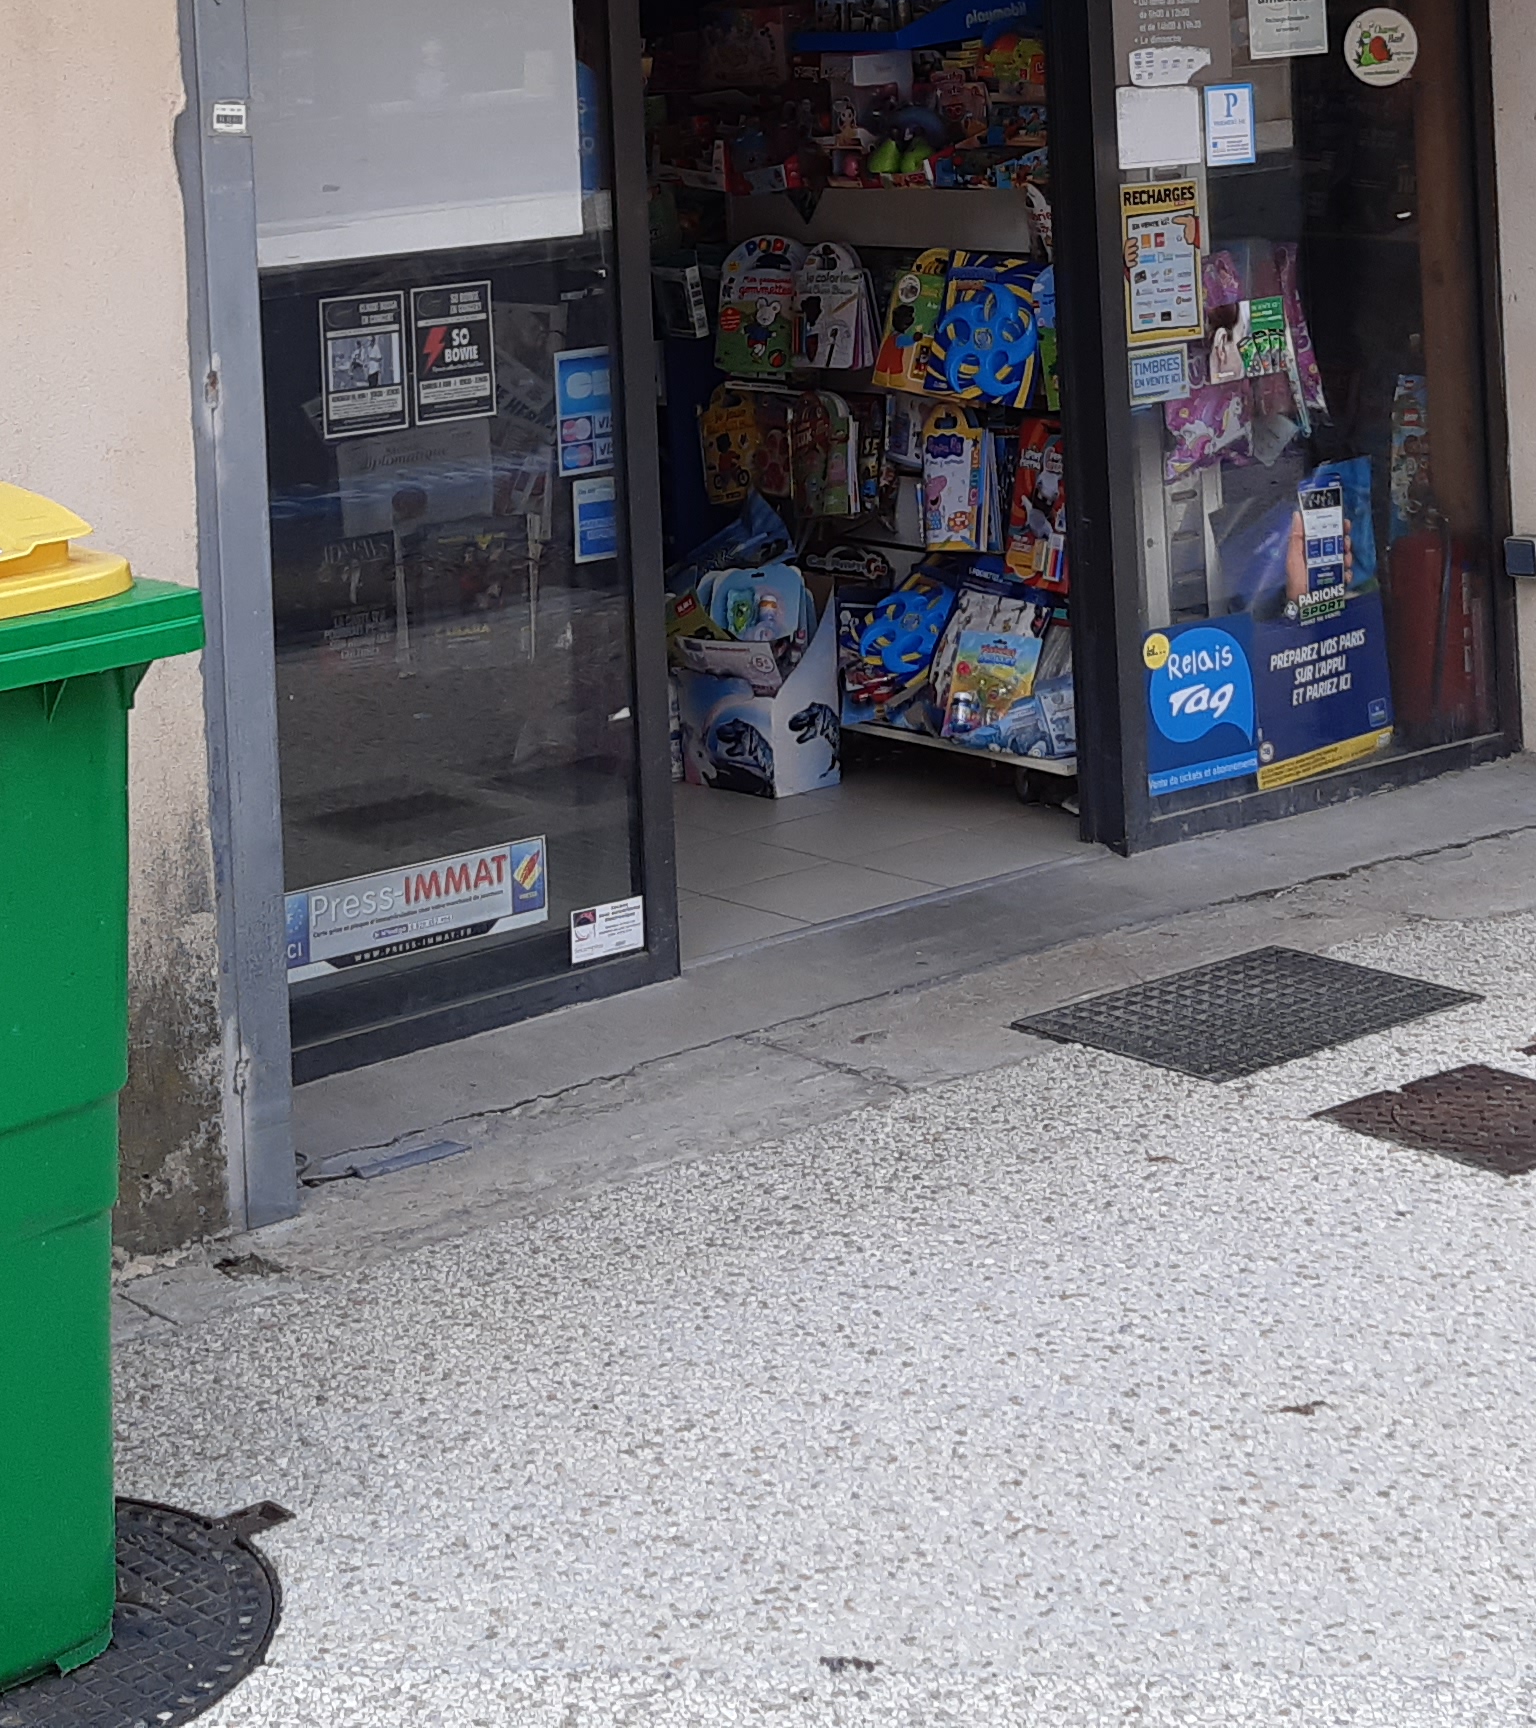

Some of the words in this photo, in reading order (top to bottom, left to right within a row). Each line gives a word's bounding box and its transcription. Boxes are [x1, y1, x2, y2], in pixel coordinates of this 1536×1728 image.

[965, 1, 1027, 28] playmobil
[1123, 185, 1195, 207] RECHARGES
[451, 328, 470, 347] SO
[444, 345, 479, 363] BOWIE
[1133, 357, 1180, 376] TIMBRES
[1135, 378, 1146, 388] EN
[1147, 376, 1170, 386] VENTE
[1171, 374, 1181, 384] ICI
[1298, 583, 1345, 607] PARIONS
[1301, 598, 1346, 619] SPORT
[1270, 643, 1319, 672] PRÉPAREZ
[1320, 636, 1338, 656] VOS
[1339, 628, 1366, 652] PARIS
[1168, 644, 1233, 680] Relais
[1295, 666, 1313, 685] SUR
[1292, 688, 1304, 707] ET
[1306, 680, 1338, 703] PARIEZ
[1340, 673, 1351, 691] ICI
